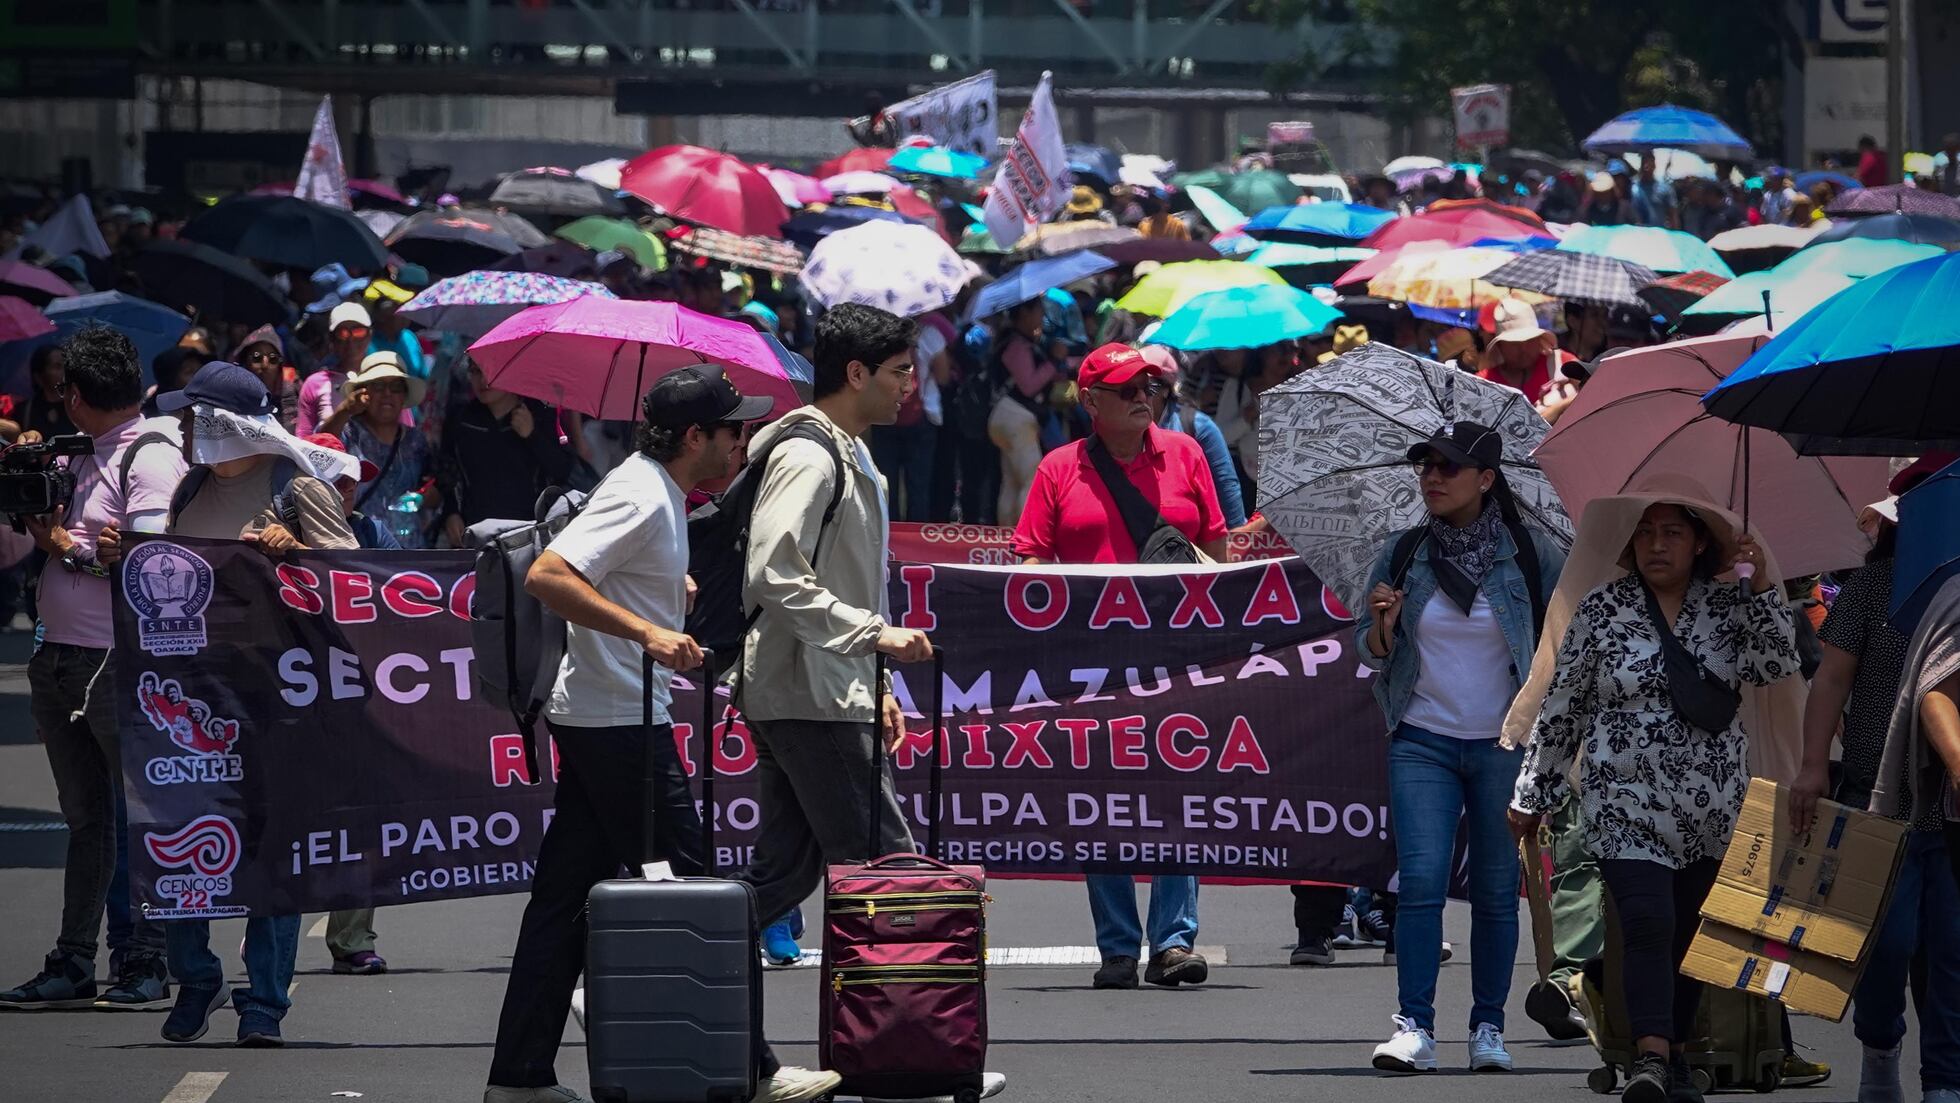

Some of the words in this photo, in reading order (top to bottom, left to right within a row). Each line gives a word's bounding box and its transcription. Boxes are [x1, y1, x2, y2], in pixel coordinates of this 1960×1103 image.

[157, 545, 169, 553] AL
[170, 547, 203, 568] SERVICIO
[968, 548, 1023, 565] SIN
[131, 587, 140, 598] LA
[186, 586, 207, 614] PUEBLO
[137, 598, 153, 614] POR
[896, 713, 1270, 775] MIXTECA
[146, 756, 244, 784] CNTE
[291, 829, 363, 875] ¡EL
[381, 811, 521, 858] PARO
[896, 792, 1048, 827] ULPA
[1067, 793, 1163, 828] DEL
[1183, 795, 1388, 840] ESTADO!
[1075, 841, 1108, 863] SE
[1119, 842, 1289, 868] DEFIENDEN!
[1742, 832, 1767, 878] U0675
[160, 877, 228, 895] CENCOS
[180, 891, 208, 908] 22
[202, 907, 246, 915] PROPAGANDA
